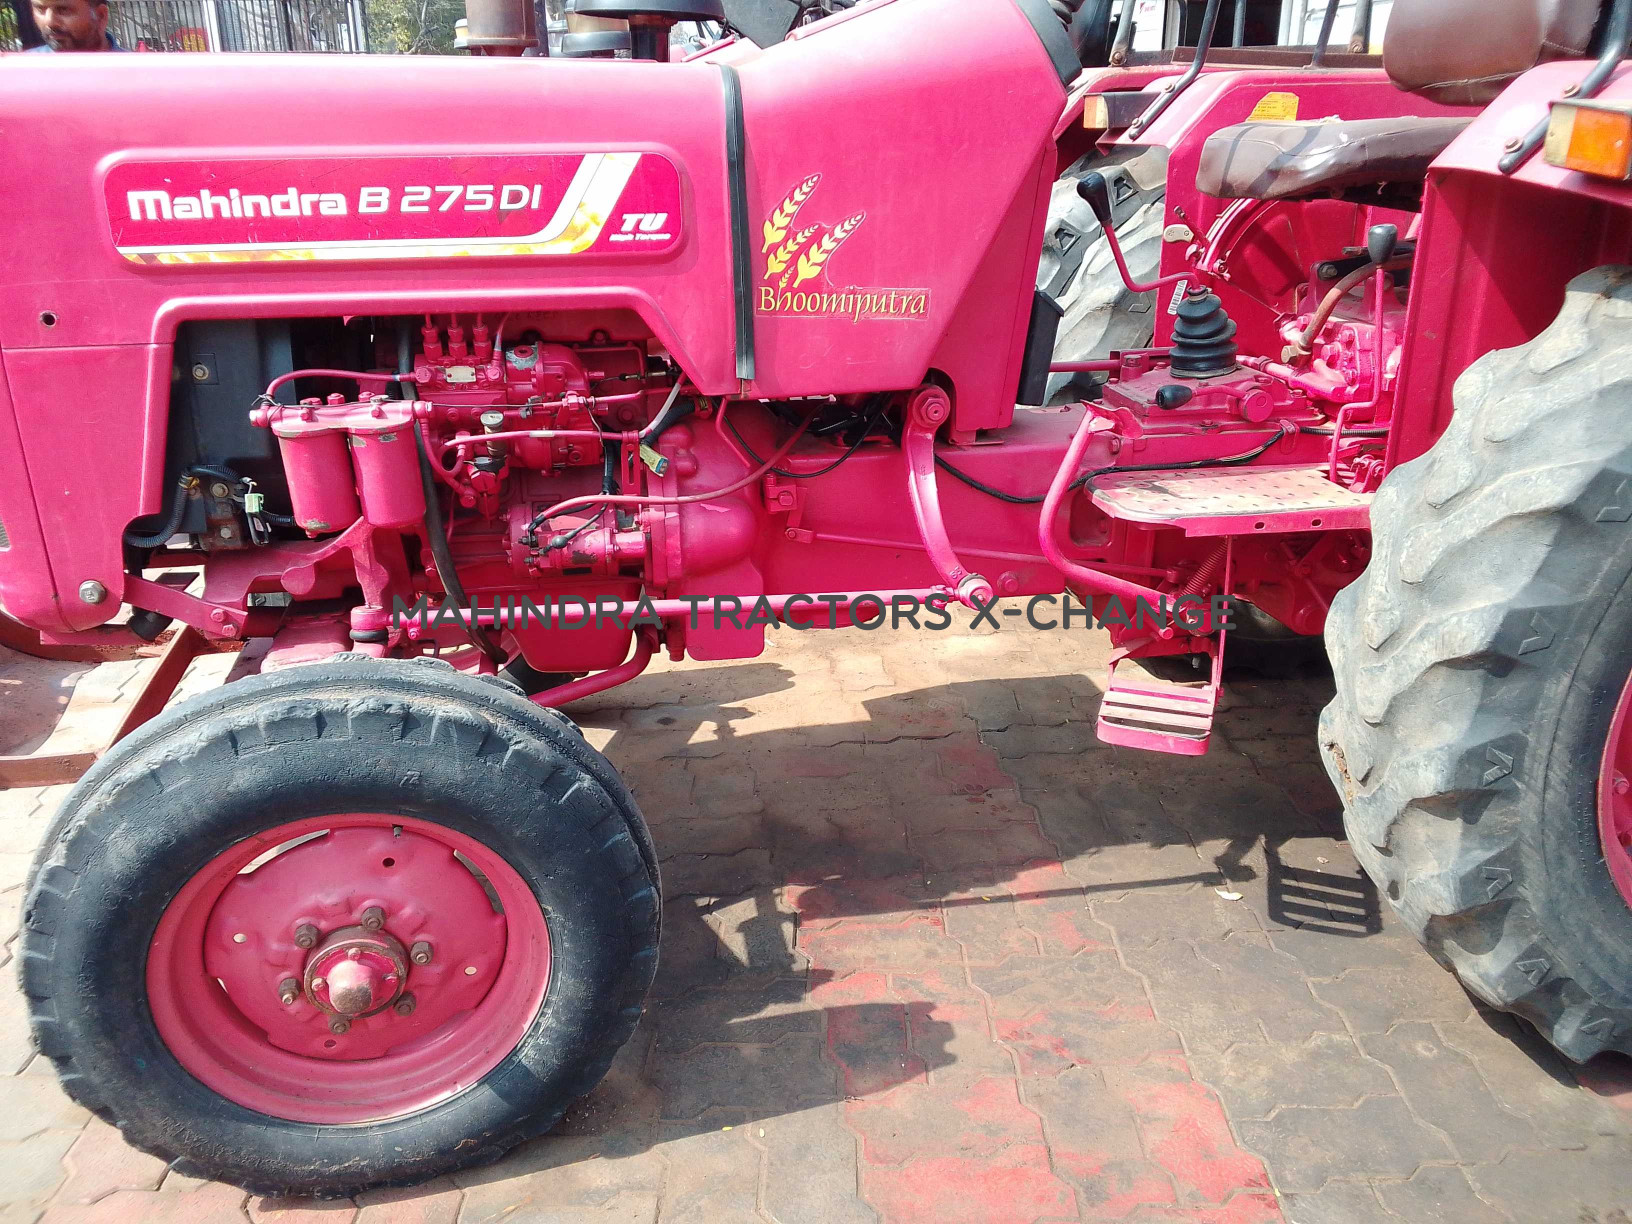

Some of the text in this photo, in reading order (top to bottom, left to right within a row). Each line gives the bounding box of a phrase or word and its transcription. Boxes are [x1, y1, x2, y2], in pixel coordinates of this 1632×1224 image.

[125, 183, 543, 221] Mahindra B 275 DI
[620, 212, 668, 231] TU
[758, 286, 927, 323] Bhoomiputra
